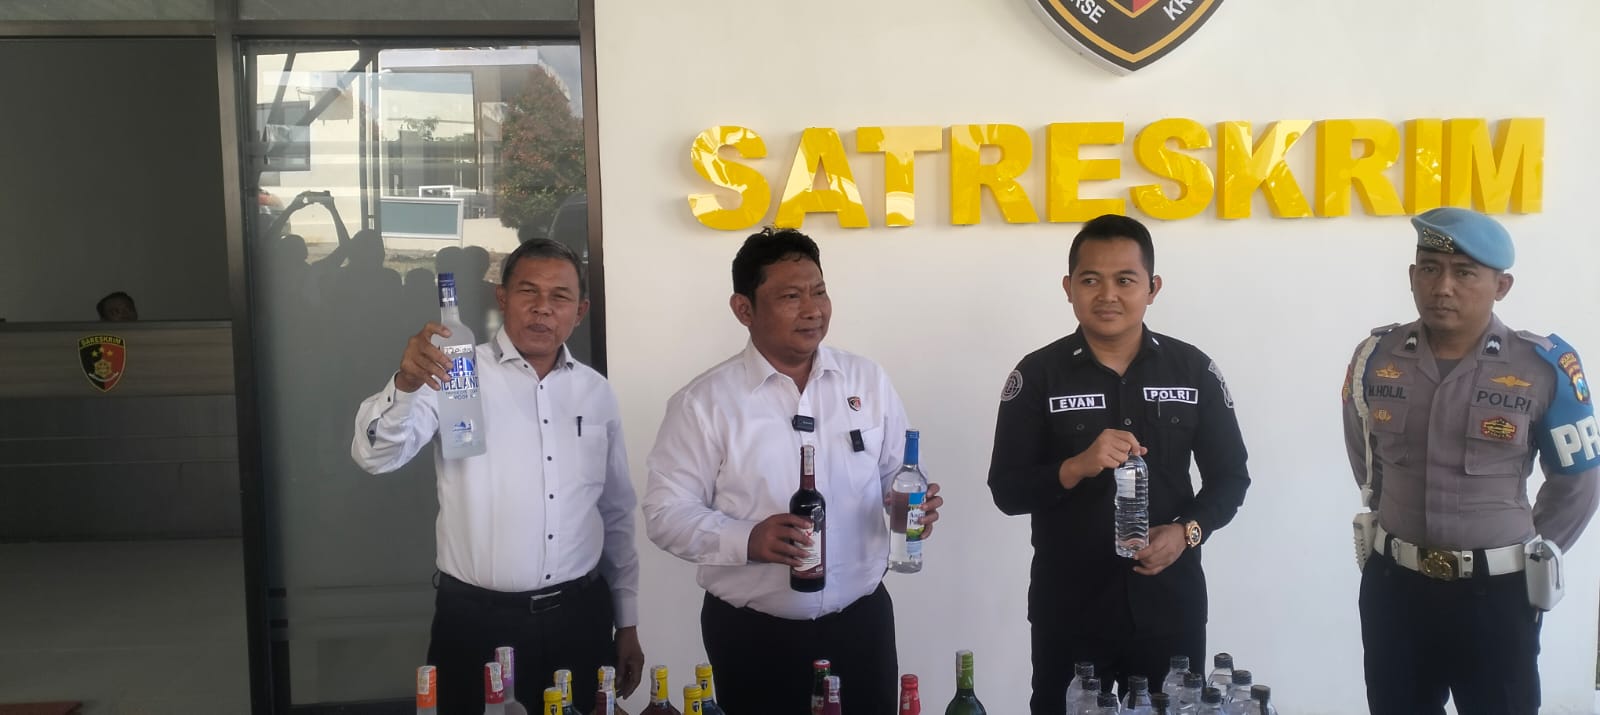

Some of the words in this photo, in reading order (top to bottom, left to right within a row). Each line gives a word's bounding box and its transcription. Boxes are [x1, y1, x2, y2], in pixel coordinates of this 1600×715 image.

[687, 116, 1546, 230] SATRESKRIM
[1059, 397, 1095, 409] EVAN
[1149, 389, 1191, 402] POLRI
[1476, 390, 1532, 412] POLRI
